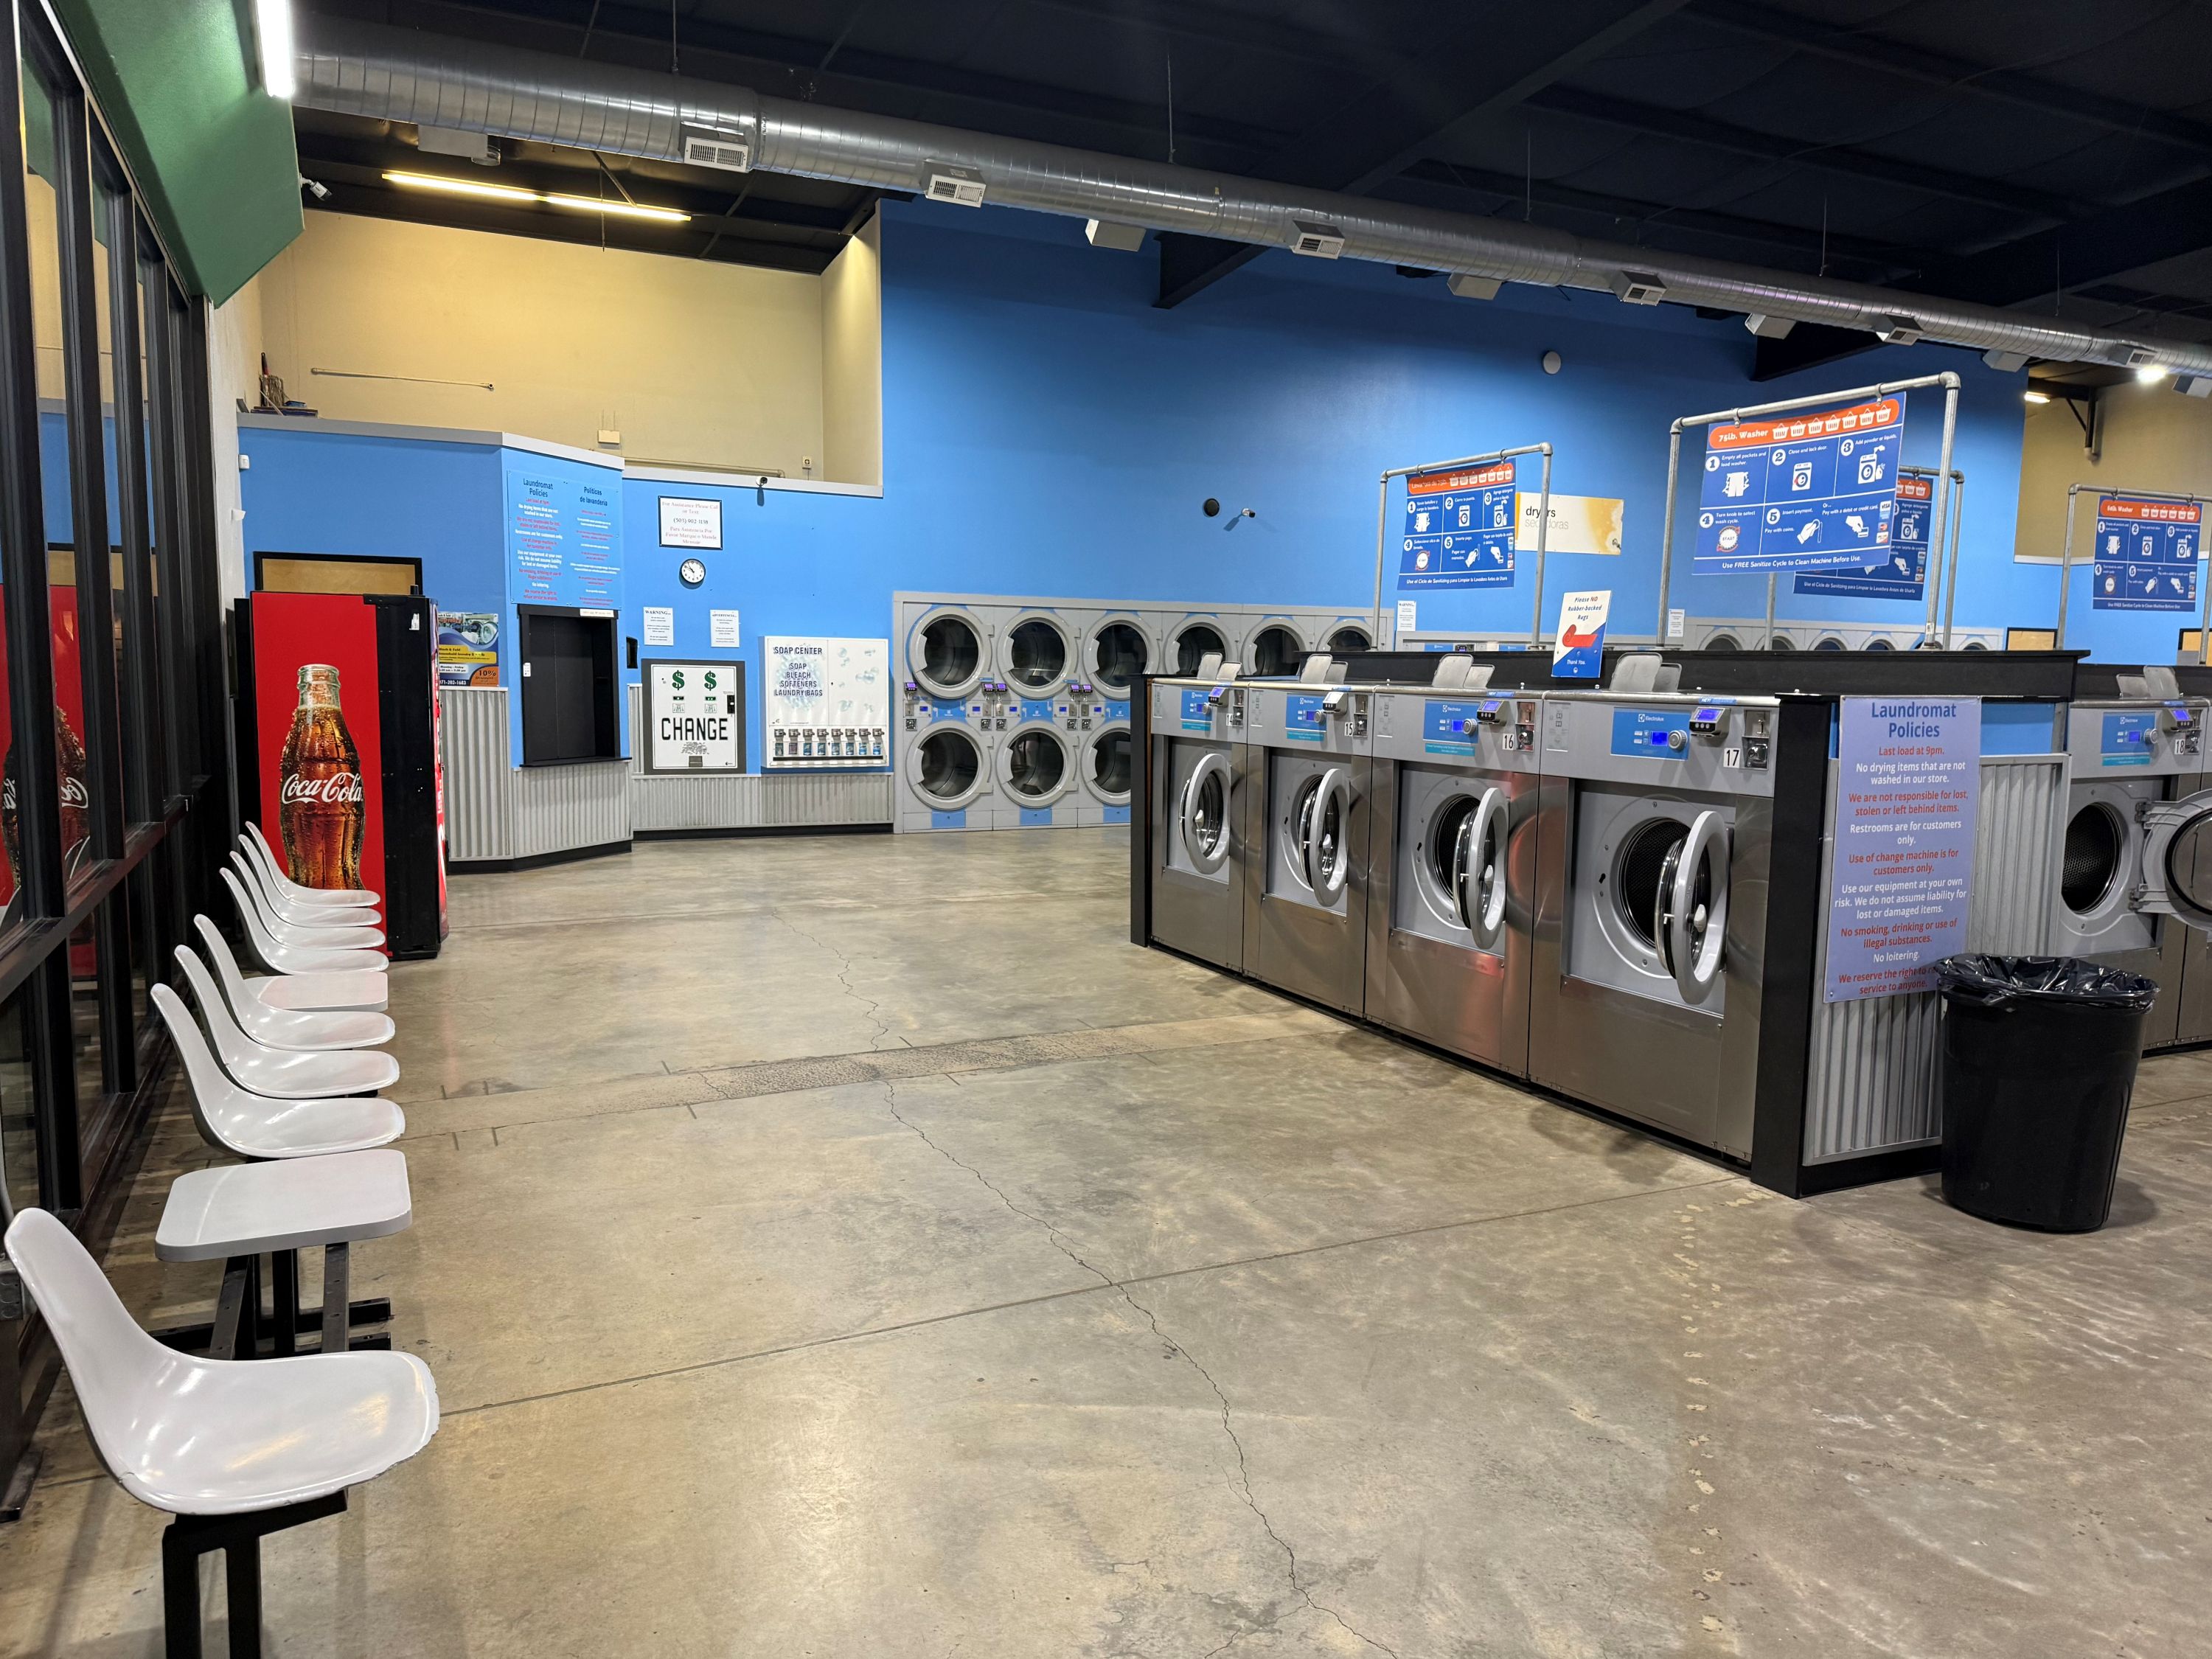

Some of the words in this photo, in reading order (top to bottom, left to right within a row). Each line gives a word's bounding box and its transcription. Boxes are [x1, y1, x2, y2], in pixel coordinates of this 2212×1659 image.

[1719, 434, 1737, 442] 75lb.
[1739, 430, 1768, 439] Washer
[1844, 442, 1851, 452] 3
[1710, 459, 1715, 468] 1
[1775, 452, 1783, 462] 2
[524, 478, 553, 490] Laundromat
[529, 488, 548, 498] Policies
[1526, 506, 1556, 518] dryrs
[1770, 512, 1777, 521] 5
[1703, 515, 1710, 524] 4
[672, 670, 684, 690] $
[704, 671, 717, 691] $
[1871, 702, 1956, 717] Laundromat
[661, 717, 728, 740] CHANGE
[1345, 723, 1353, 736] 15
[1889, 722, 1940, 737] Policies
[1504, 734, 1514, 749] 16
[2176, 740, 2185, 754] 18
[1726, 749, 1739, 767] 17
[1879, 747, 1895, 756] Last
[1897, 746, 1914, 755] load
[1916, 747, 1924, 755] at
[1926, 746, 1944, 757] 9pm.
[1856, 763, 1868, 772] No
[1870, 762, 1896, 774] drying
[1897, 762, 1919, 771] items
[1921, 762, 1936, 770] that
[1871, 775, 1901, 785] washed
[1903, 775, 1910, 783] in
[1928, 774, 1950, 783] store.
[282, 772, 363, 804] Coca-Cola
[1848, 793, 1862, 802] We
[1879, 793, 1892, 801] not
[1895, 791, 1938, 803] responsible
[1941, 790, 1951, 799] for
[1953, 790, 1968, 800] lost,
[1855, 807, 1879, 815] stolen
[1882, 807, 1891, 815] or
[1893, 804, 1906, 815] left
[1909, 804, 1935, 813] behind
[1937, 803, 1959, 812] items.
[1851, 823, 1893, 833] Restrooms
[1895, 822, 1907, 830] are
[1910, 821, 1921, 830] for
[1923, 820, 1961, 830] customers
[1897, 835, 1916, 846] only.
[1849, 855, 1864, 863] Use
[1865, 853, 1875, 862] of
[1876, 852, 1904, 863] change
[1906, 850, 1938, 860] machine
[1941, 849, 1947, 858] is
[1948, 849, 1958, 858] for
[1873, 865, 1914, 875] customers
[1916, 863, 1934, 874] only.
[1842, 884, 1857, 894] Use
[1859, 884, 1872, 892] our
[1874, 880, 1917, 893] equipment
[1919, 880, 1927, 888] at
[1928, 880, 1944, 890] your
[1947, 878, 1963, 886] own
[1834, 898, 1852, 908] risk.
[1854, 897, 1868, 906] We
[1869, 895, 1879, 905] do
[1881, 894, 1894, 904] not
[1896, 893, 1925, 903] assume
[1927, 890, 1955, 901] liability
[1956, 890, 1966, 899] for
[1857, 910, 1871, 919] lost
[1874, 910, 1882, 918] or
[1884, 906, 1919, 919] damaged
[1921, 905, 1943, 914] items.
[1841, 928, 1852, 936] No
[1854, 925, 1889, 938] smoking,
[1892, 922, 1924, 934] drinking
[1935, 920, 1947, 928] use
[1950, 918, 1958, 927] of
[1863, 938, 1887, 950] illegal
[1888, 934, 1932, 946] substances.
[1874, 953, 1884, 963] No
[1886, 950, 1919, 961] loitering.
[1839, 975, 1851, 984] We
[1853, 973, 1882, 982] reserve
[1884, 970, 1896, 979] the
[1899, 967, 1916, 978] right
[1860, 982, 1887, 995] service
[1889, 982, 1896, 991] to
[1898, 978, 1927, 991] anyone.
